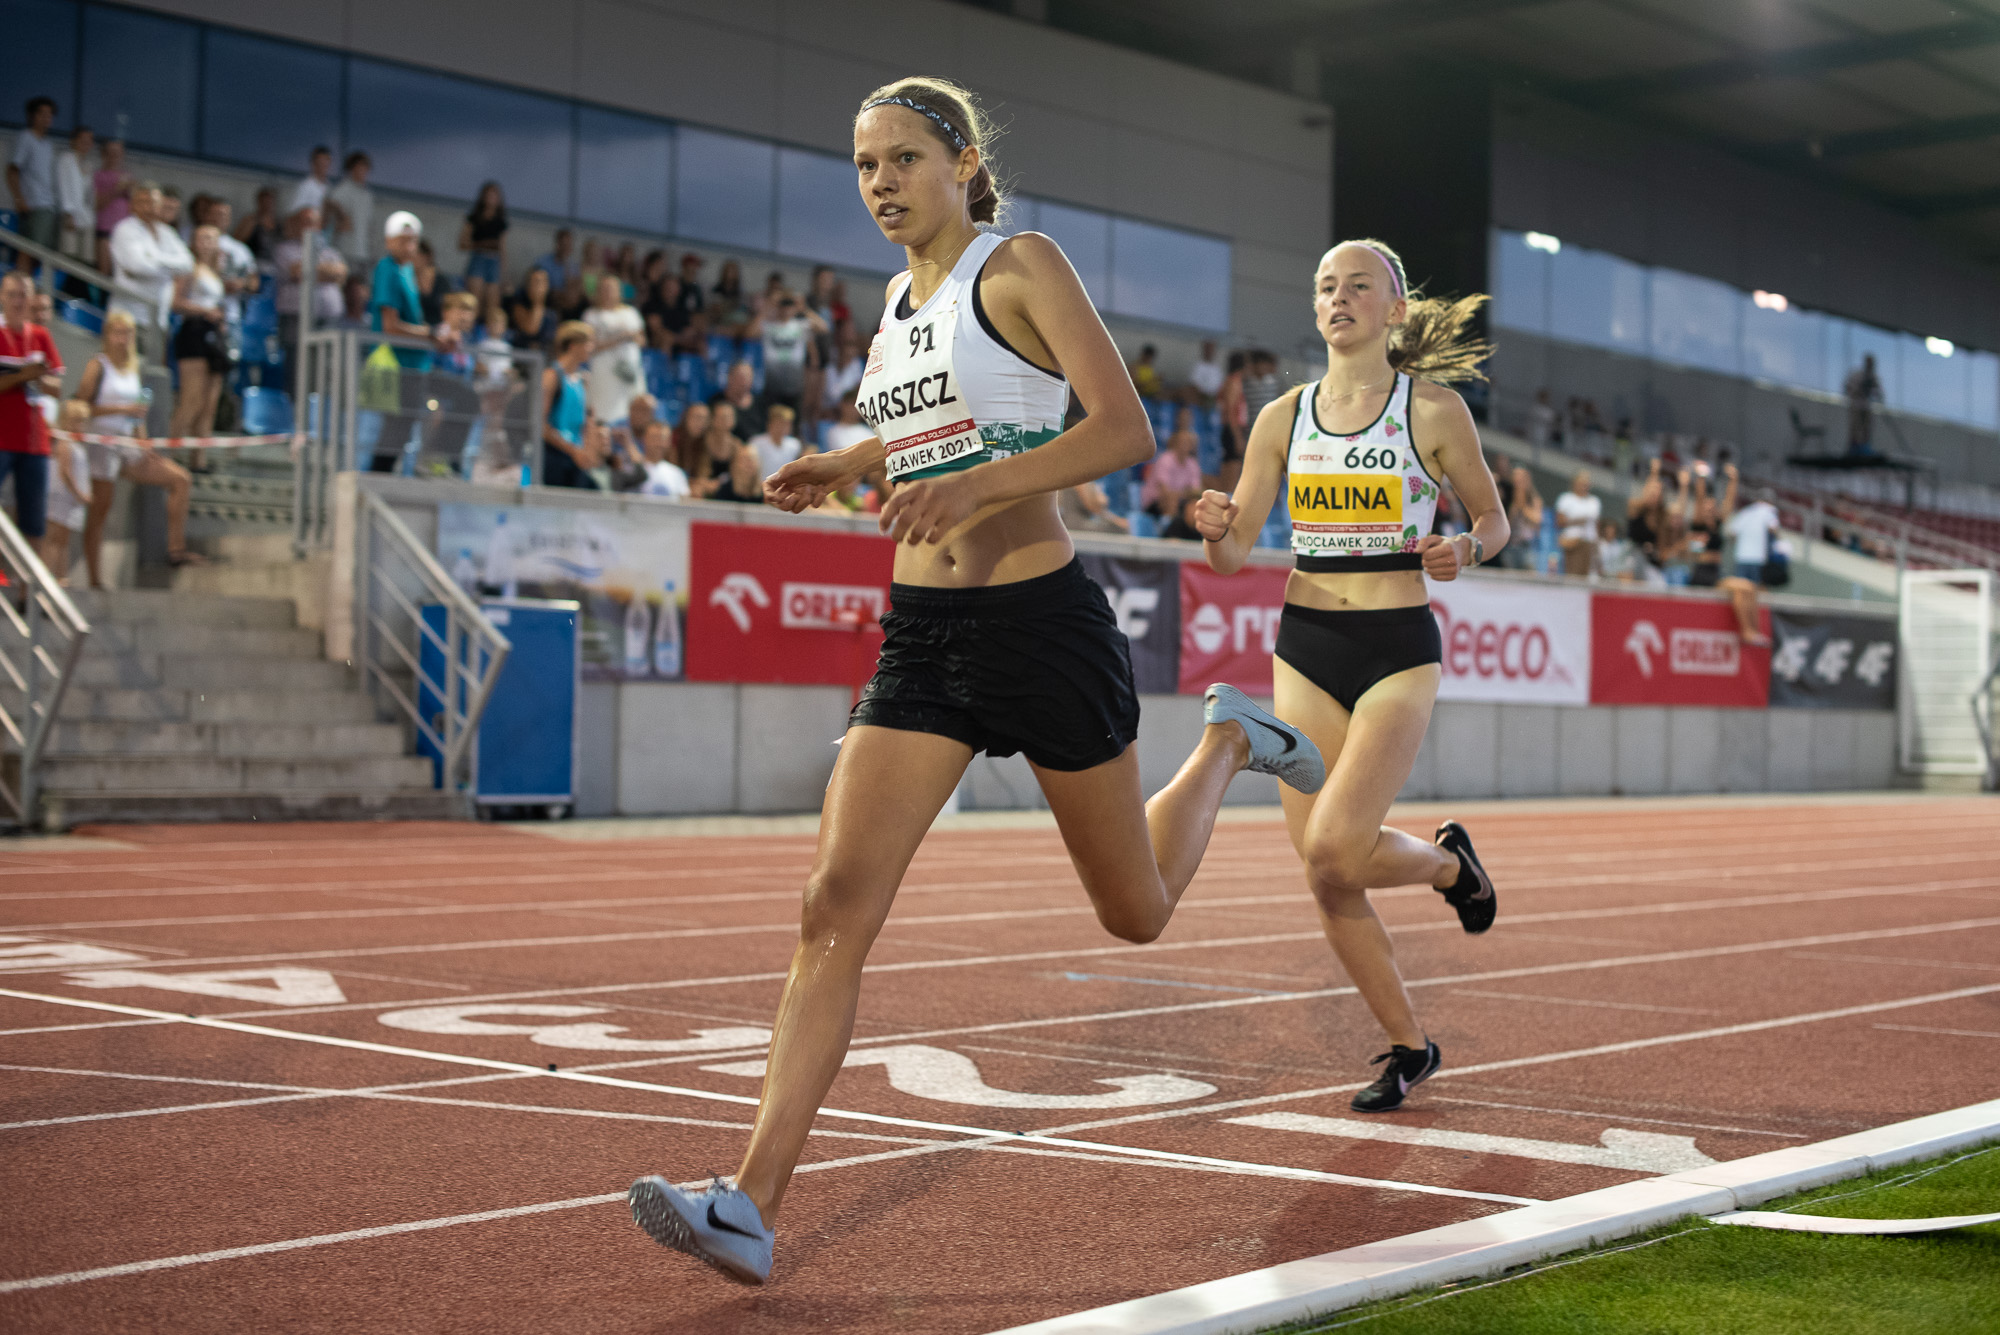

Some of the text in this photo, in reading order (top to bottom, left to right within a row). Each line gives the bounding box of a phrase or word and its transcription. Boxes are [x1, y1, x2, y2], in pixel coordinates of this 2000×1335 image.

[909, 321, 936, 358] 91
[858, 370, 957, 428] BARSZCZ
[928, 427, 952, 440] POLSKI
[938, 437, 972, 459] 2021
[1344, 446, 1396, 469] 660
[1294, 486, 1391, 510] MALINA
[1297, 535, 1395, 548] WŁOCŁAWEK 2021
[1104, 586, 1159, 640] F
[59, 966, 348, 1006] 4
[377, 1003, 775, 1052] 3
[698, 1044, 1219, 1109] 2
[1216, 1111, 1723, 1175] 1
